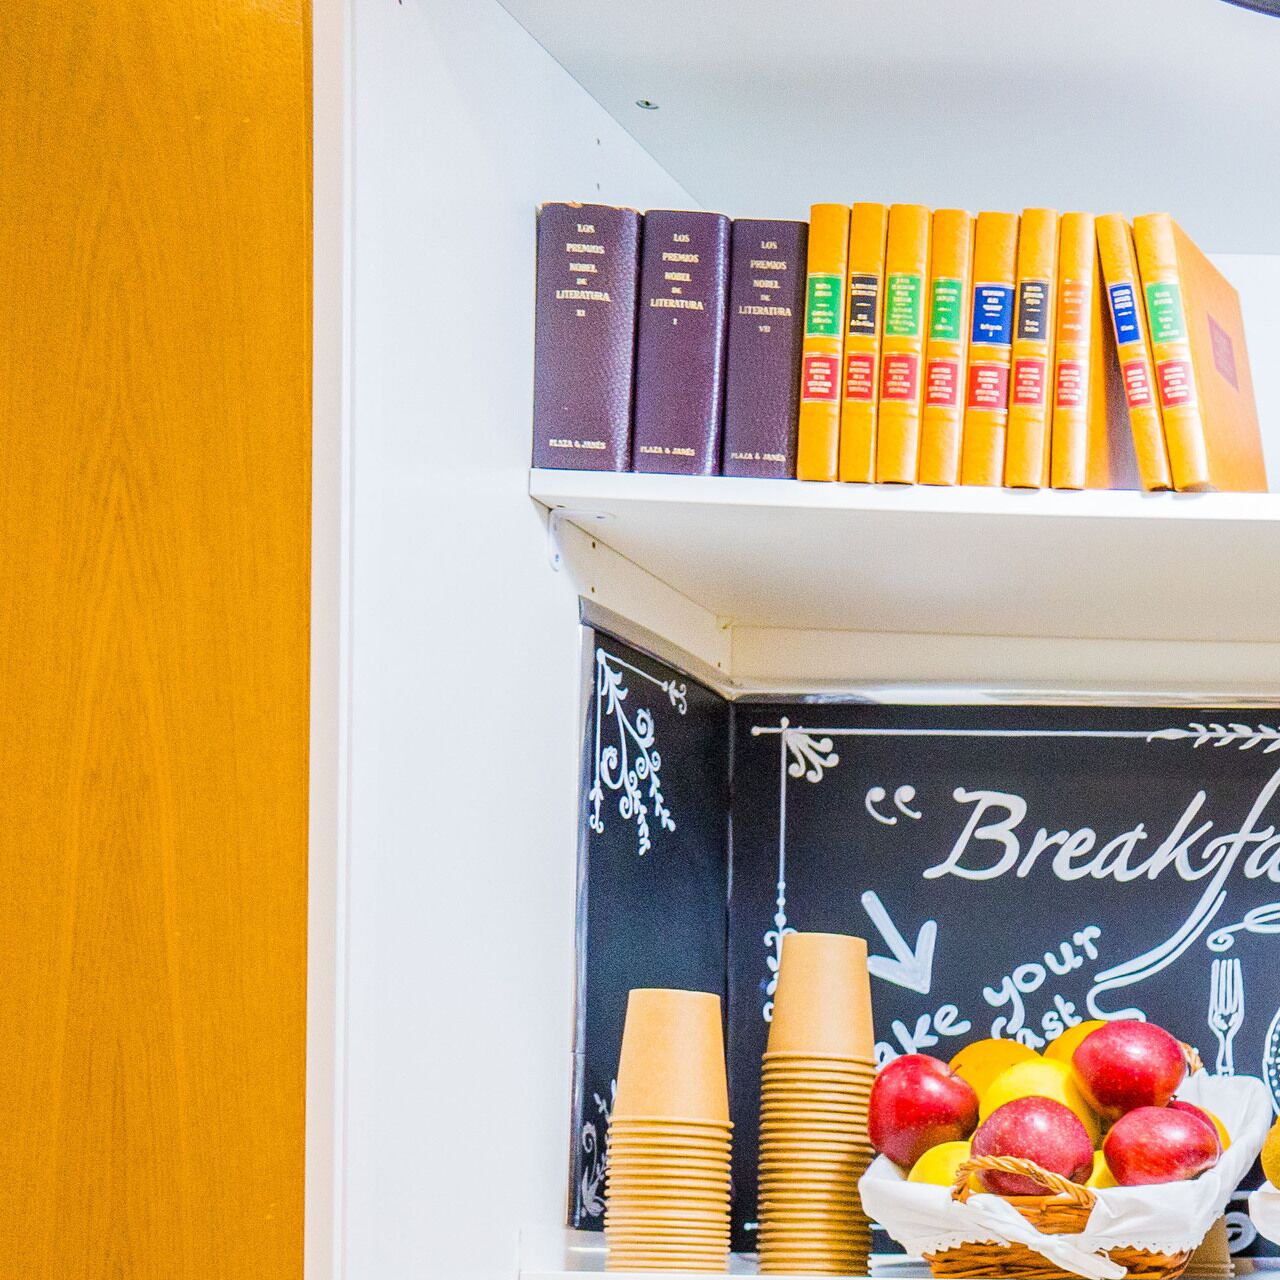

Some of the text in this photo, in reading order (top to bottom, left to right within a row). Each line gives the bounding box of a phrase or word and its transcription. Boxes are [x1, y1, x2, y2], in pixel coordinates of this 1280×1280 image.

[578, 224, 595, 233] LOS
[673, 234, 690, 242] LOS
[761, 241, 777, 249] LOS
[556, 290, 610, 302] LITERATURA
[650, 299, 703, 310] LITERATURA
[739, 306, 791, 316] LITERATURA
[874, 926, 1101, 1072] ake your
[991, 994, 1083, 1050] ast
